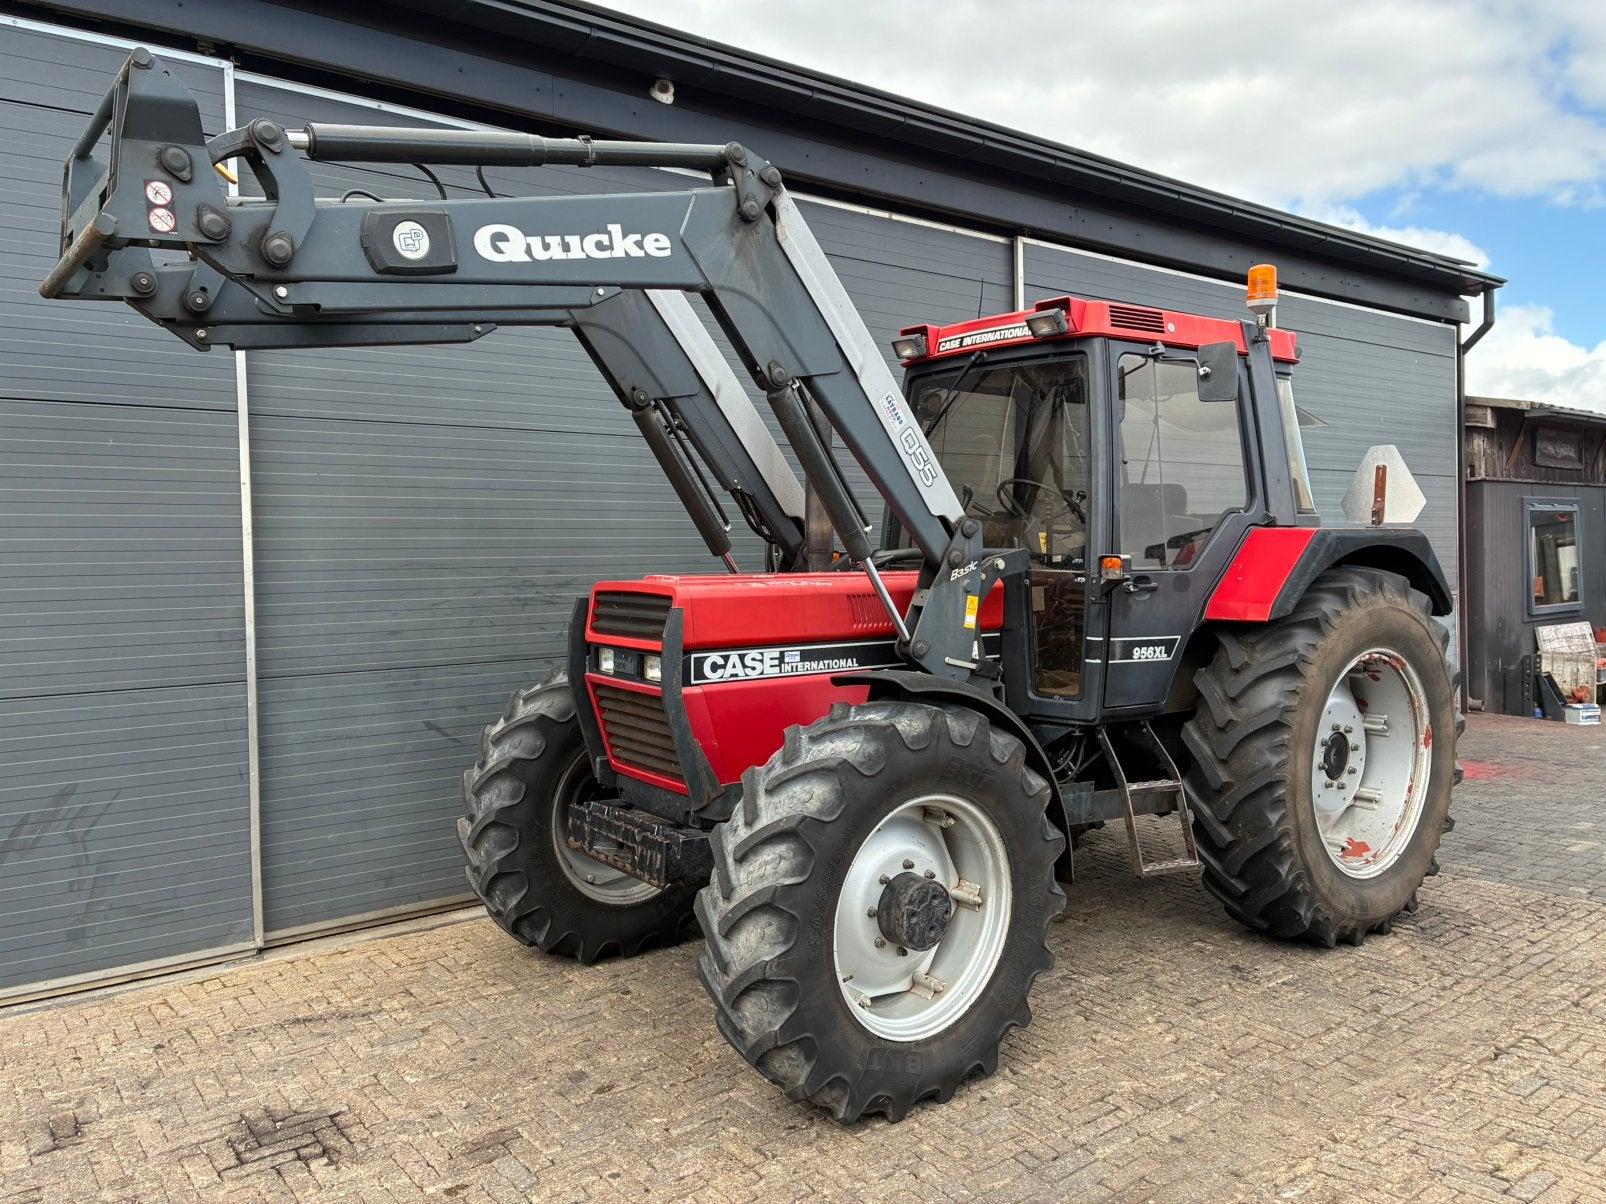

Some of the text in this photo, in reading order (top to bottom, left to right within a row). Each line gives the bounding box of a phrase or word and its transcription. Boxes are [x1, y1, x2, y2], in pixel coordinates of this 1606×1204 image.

[473, 223, 672, 263] Quicke
[940, 326, 1032, 352] CASE INTERNATIONA
[900, 426, 938, 487] Q55
[950, 560, 979, 581] Basic
[703, 651, 780, 679] CASE
[781, 657, 859, 673] INTERNATIONAL
[1132, 646, 1168, 660] 956XL
